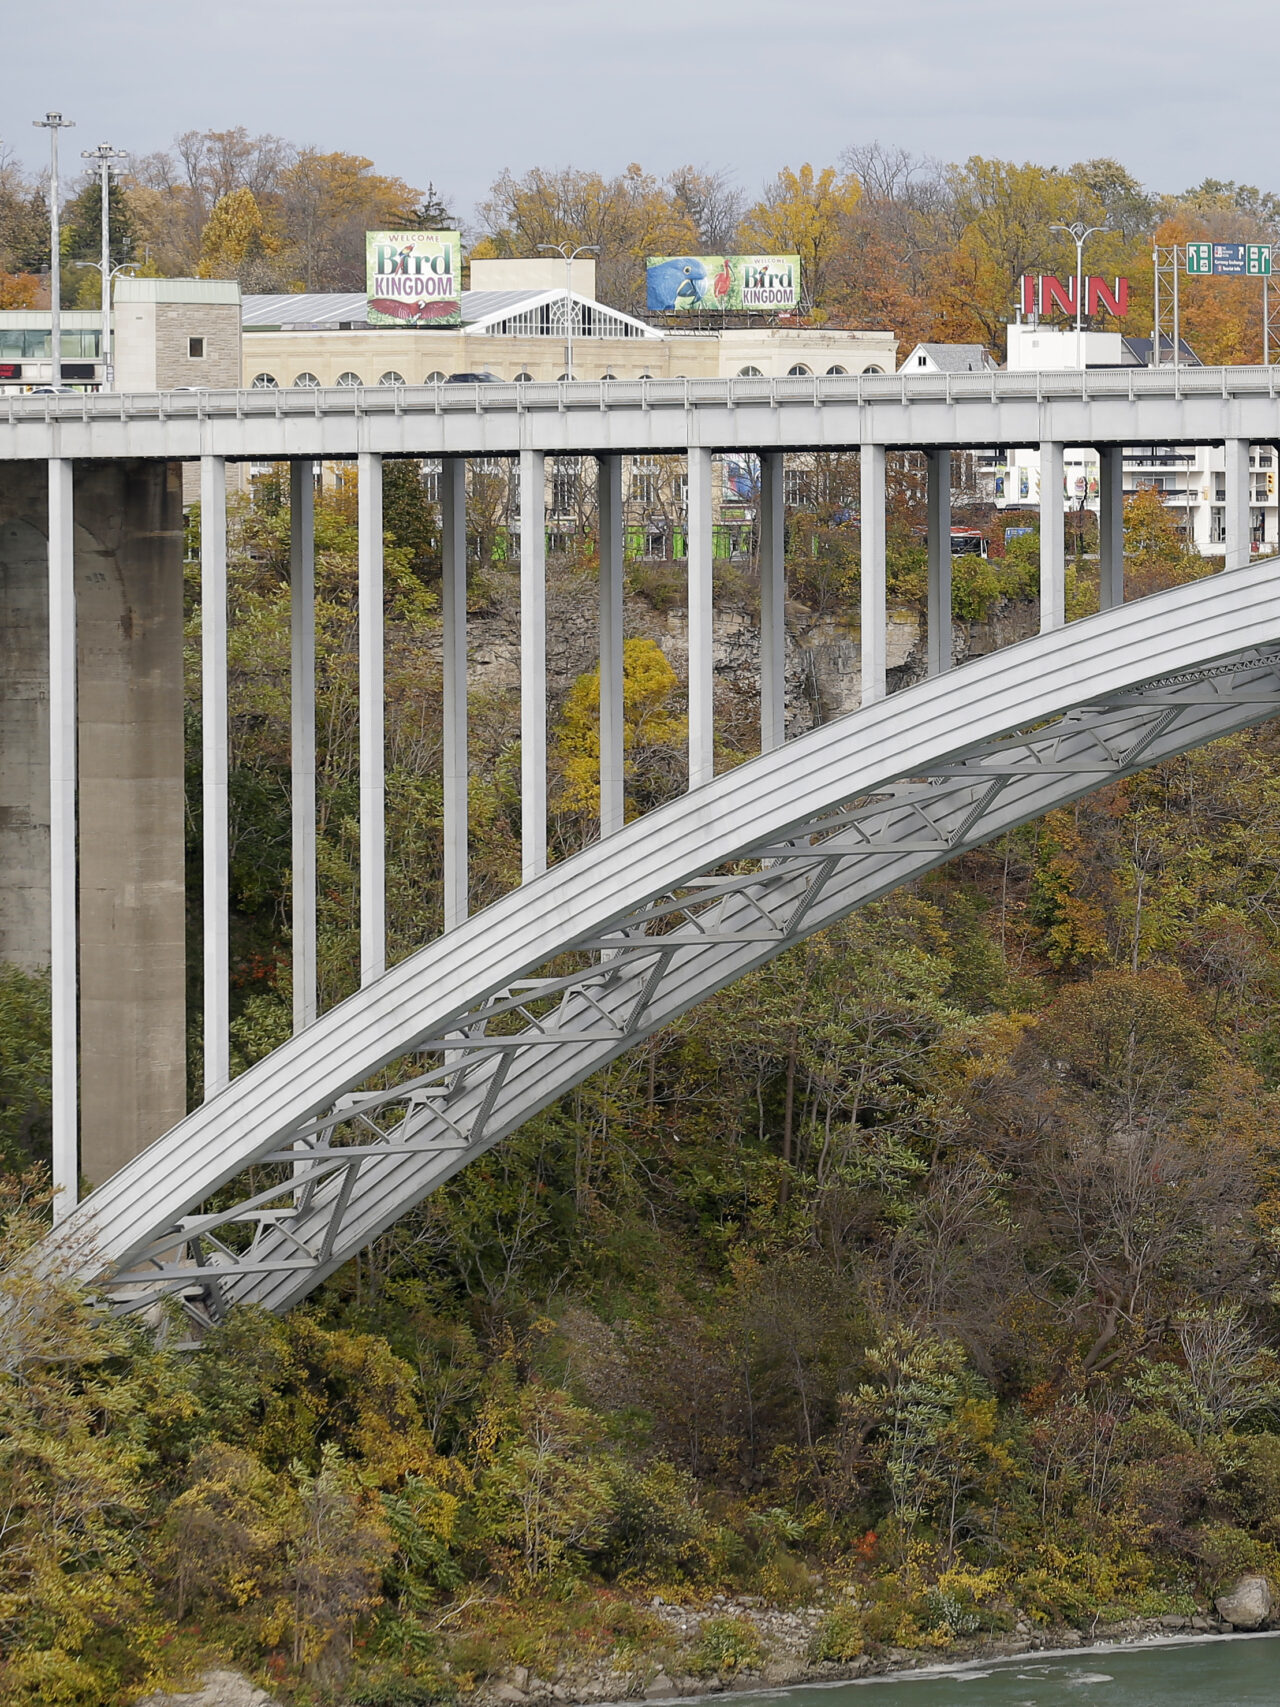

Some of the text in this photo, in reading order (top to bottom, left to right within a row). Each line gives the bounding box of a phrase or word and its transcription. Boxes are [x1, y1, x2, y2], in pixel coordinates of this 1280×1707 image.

[389, 234, 440, 242] WELCOME
[374, 243, 453, 276] Bird
[375, 277, 453, 296] KINGDOM
[743, 264, 794, 288] Bird
[743, 289, 794, 304] KINGDOM
[1020, 275, 1128, 316] INN
